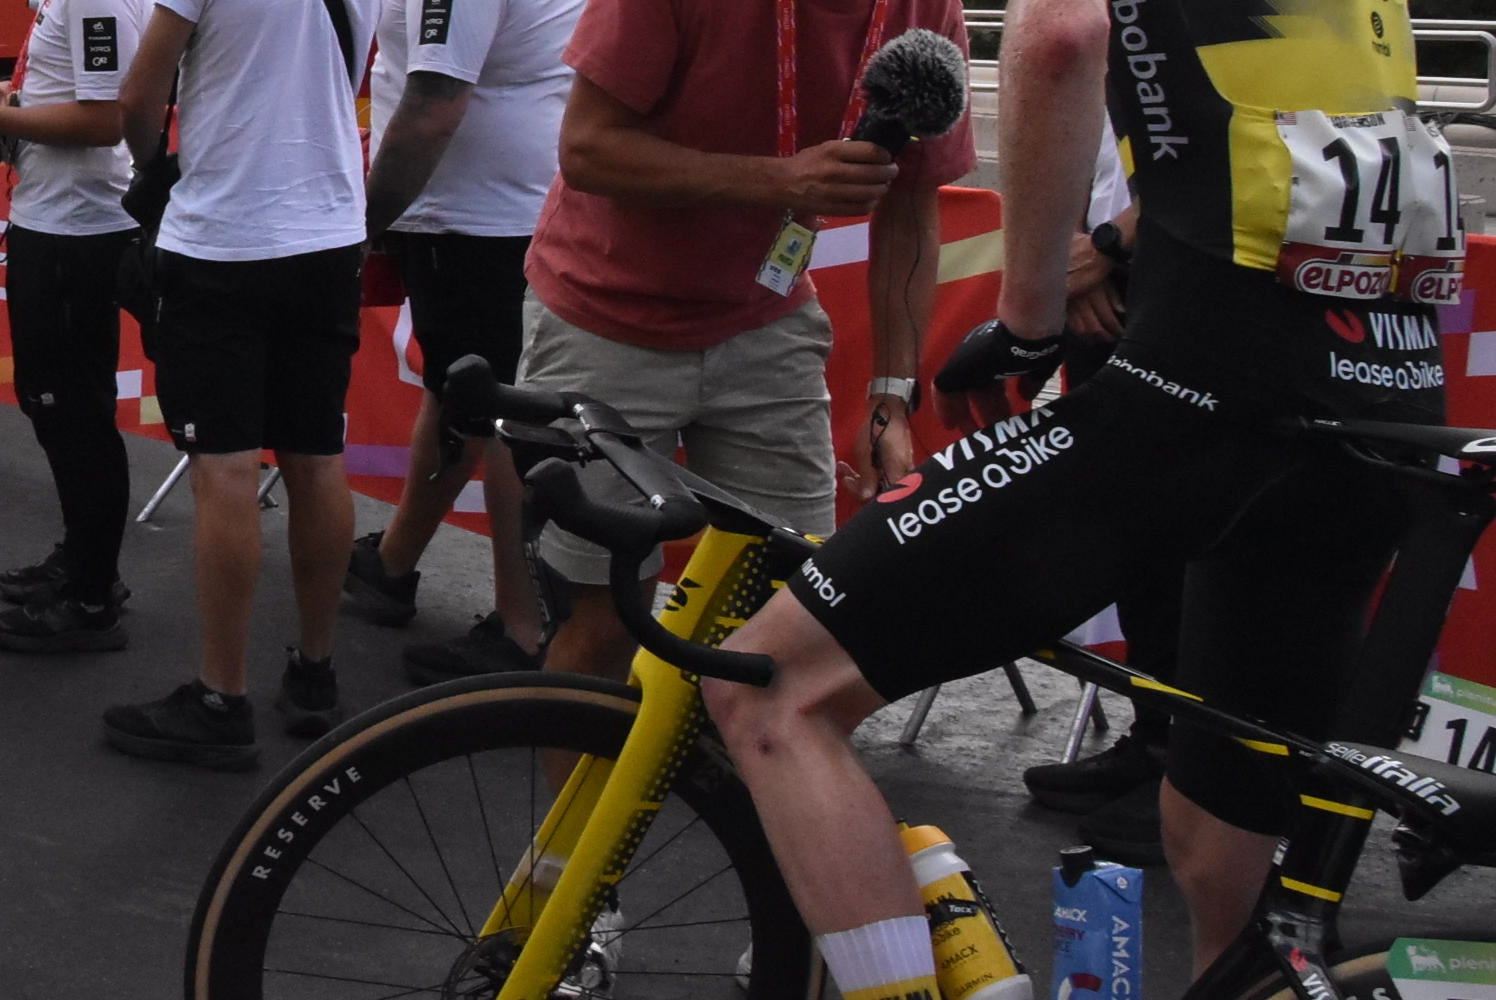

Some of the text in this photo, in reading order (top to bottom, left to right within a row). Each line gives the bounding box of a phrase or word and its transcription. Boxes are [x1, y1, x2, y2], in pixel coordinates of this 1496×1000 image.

[1322, 136, 1401, 245] 14
[1369, 312, 1437, 350] VISMA
[1330, 352, 1393, 387] lease
[887, 477, 983, 545] lease
[1324, 742, 1366, 769] selle
[251, 766, 362, 880] RESERVE
[1111, 915, 1131, 1000] AMAC
[1449, 956, 1496, 971] pleni
